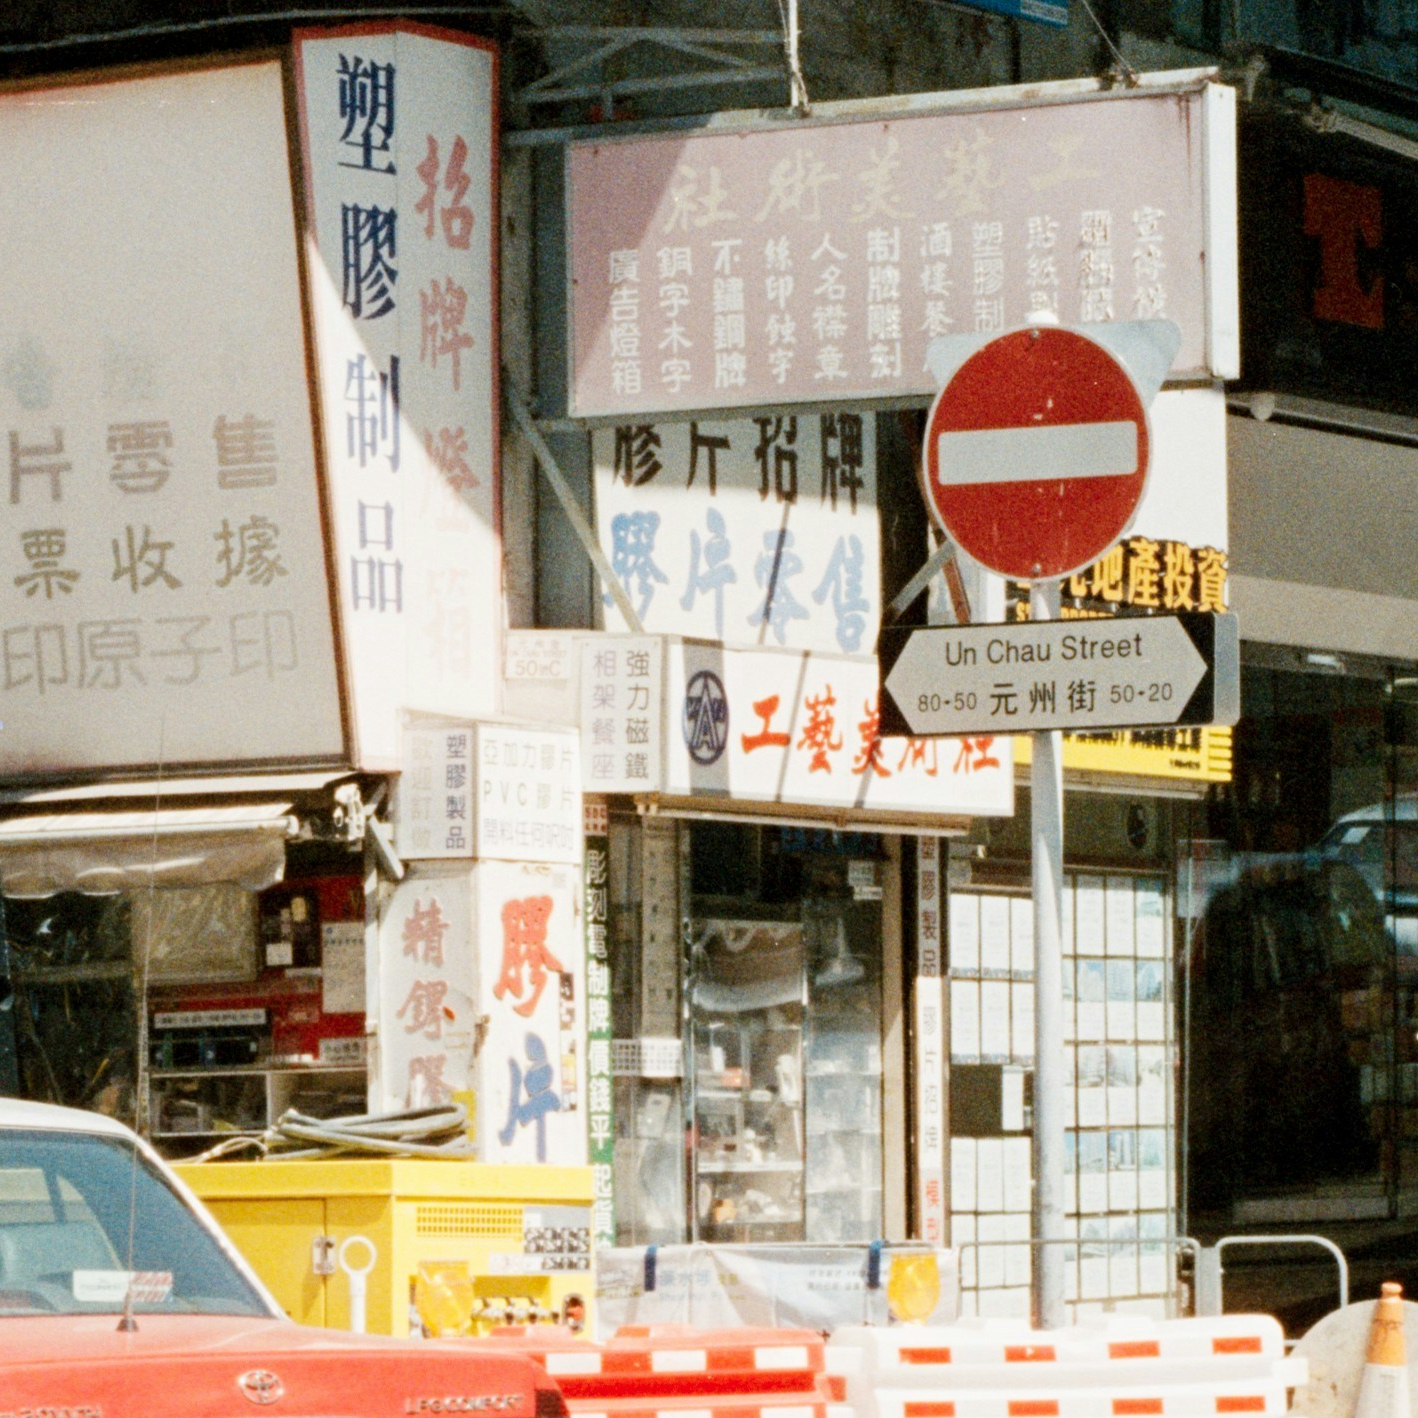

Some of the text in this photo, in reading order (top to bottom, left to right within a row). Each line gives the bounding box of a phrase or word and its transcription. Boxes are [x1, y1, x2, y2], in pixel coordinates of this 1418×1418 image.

[337, 53, 403, 613] 塑膠制品
[603, 507, 870, 655] 膠片零售
[1062, 535, 1229, 614] 地產投資
[944, 633, 1143, 667] Un Chau Street
[989, 680, 1097, 716] 元州街
[624, 650, 651, 781] 強力磁鐵
[444, 734, 467, 850] 塑膠製品
[492, 894, 565, 1164] 膠片
